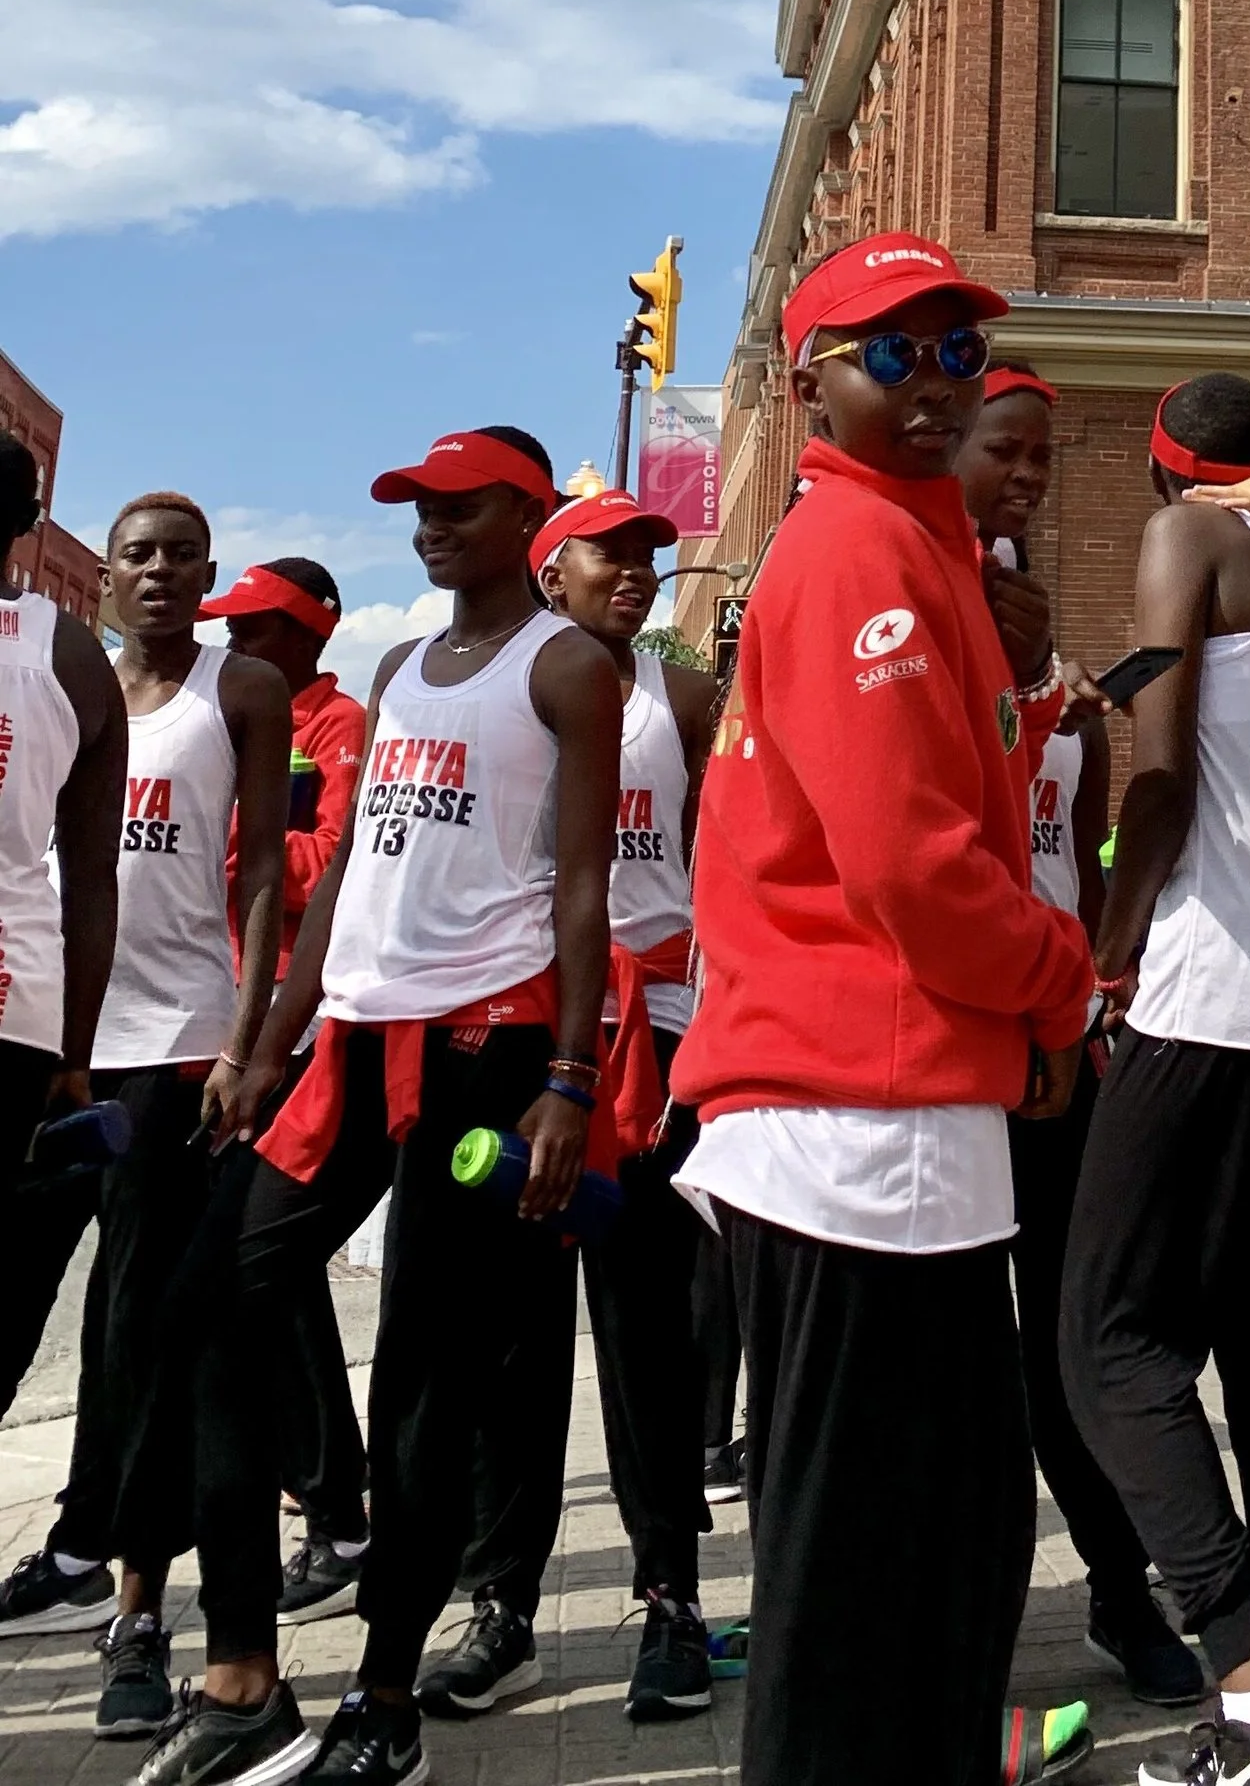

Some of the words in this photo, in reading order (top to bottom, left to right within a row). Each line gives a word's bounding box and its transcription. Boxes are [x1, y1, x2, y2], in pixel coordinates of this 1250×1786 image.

[864, 249, 944, 268] Canada
[650, 415, 715, 426] DOWNTOWN
[855, 657, 928, 691] SARACENS
[370, 738, 468, 790] KENYA
[361, 783, 477, 827] CROSSE
[371, 817, 408, 857] 13
